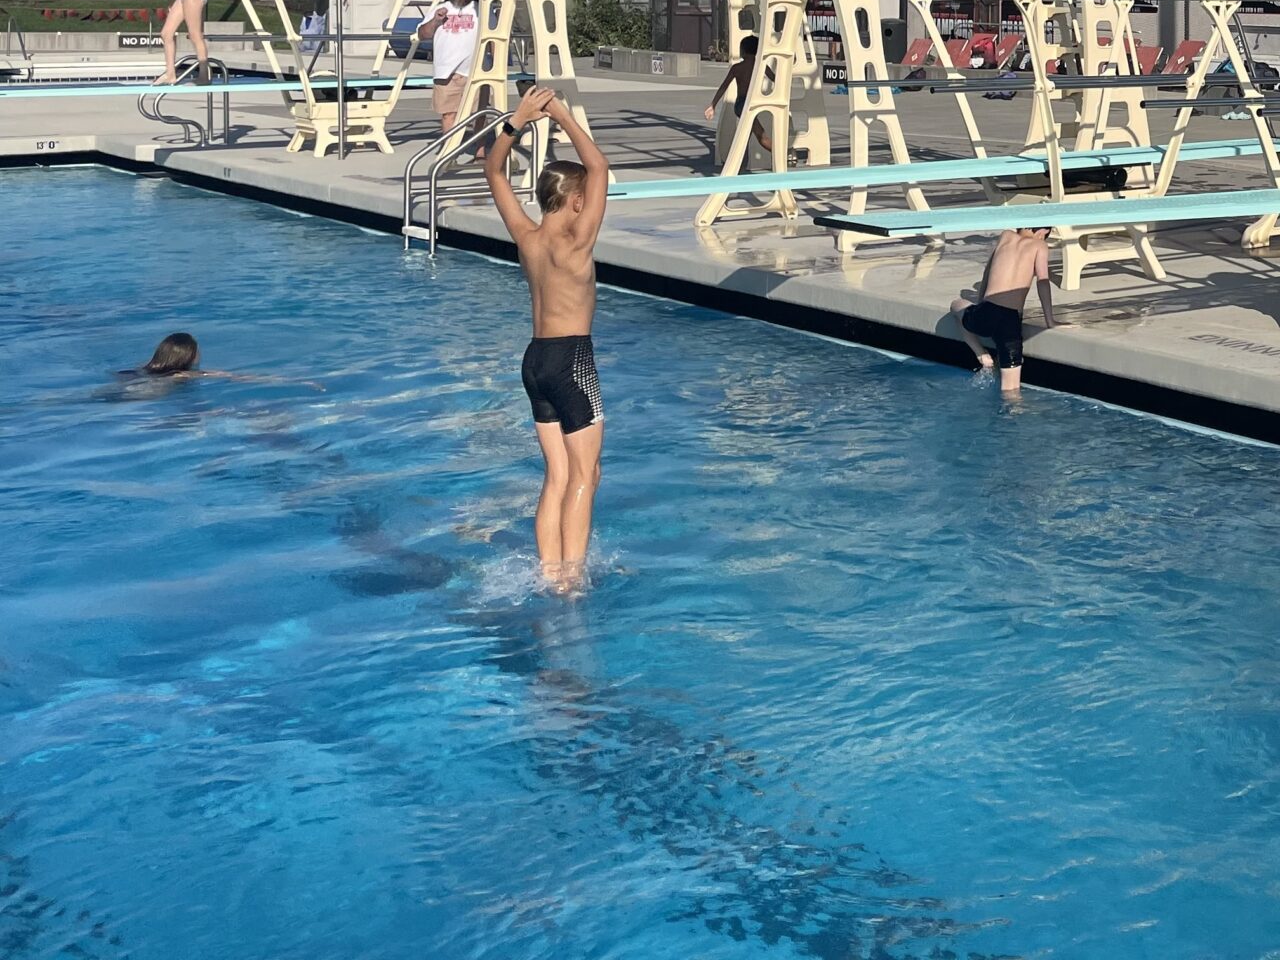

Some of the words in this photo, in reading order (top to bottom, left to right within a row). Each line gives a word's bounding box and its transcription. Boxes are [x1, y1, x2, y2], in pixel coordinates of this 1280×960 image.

[122, 37, 138, 45] NO
[139, 37, 165, 45] DIVIN
[825, 69, 838, 79] NO
